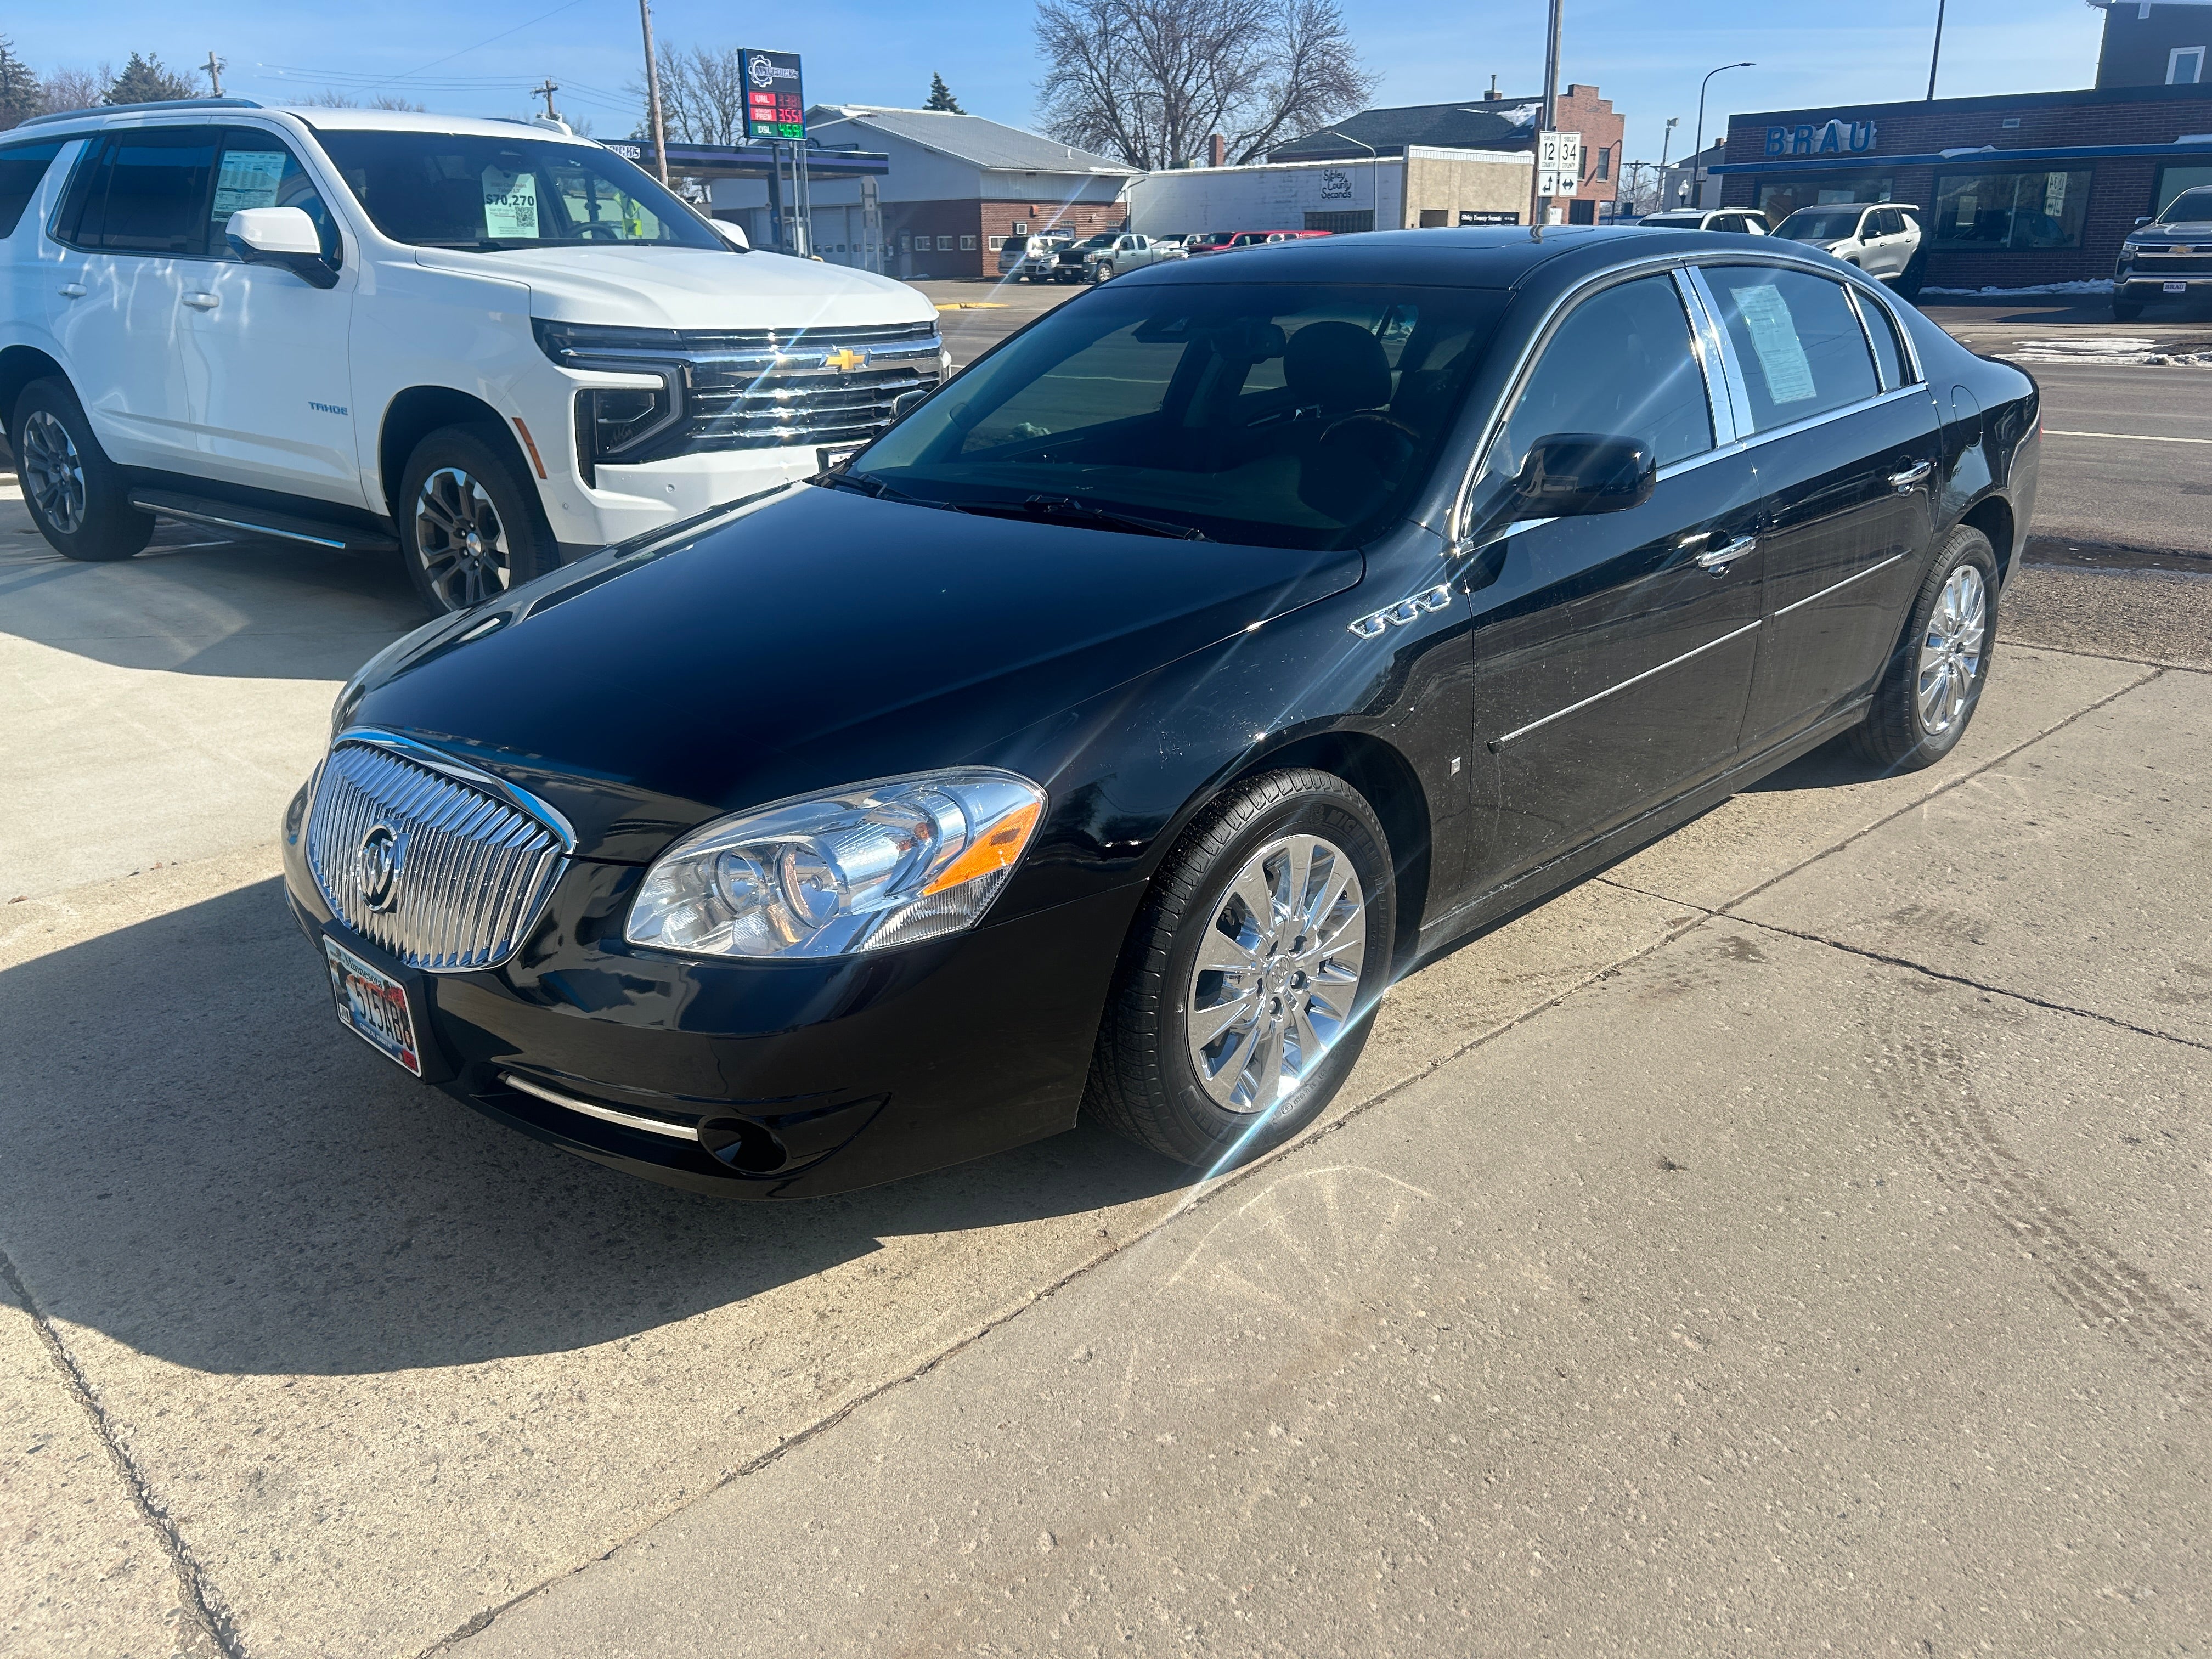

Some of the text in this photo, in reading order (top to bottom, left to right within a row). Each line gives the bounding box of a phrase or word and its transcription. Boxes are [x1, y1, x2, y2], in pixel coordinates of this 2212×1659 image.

[754, 94, 770, 104] UNL
[757, 125, 772, 134] DSL
[1764, 121, 1873, 157] BRAU
[1544, 143, 1555, 160] 12
[1562, 143, 1576, 161] 34
[1323, 169, 1346, 182] Sibley
[1328, 178, 1352, 192] County
[1321, 187, 1352, 199] Seconds
[486, 194, 534, 207] $70,270
[308, 401, 348, 416] TAHOE
[1325, 809, 1386, 876] MICHELIN
[344, 953, 383, 990] Minnesota
